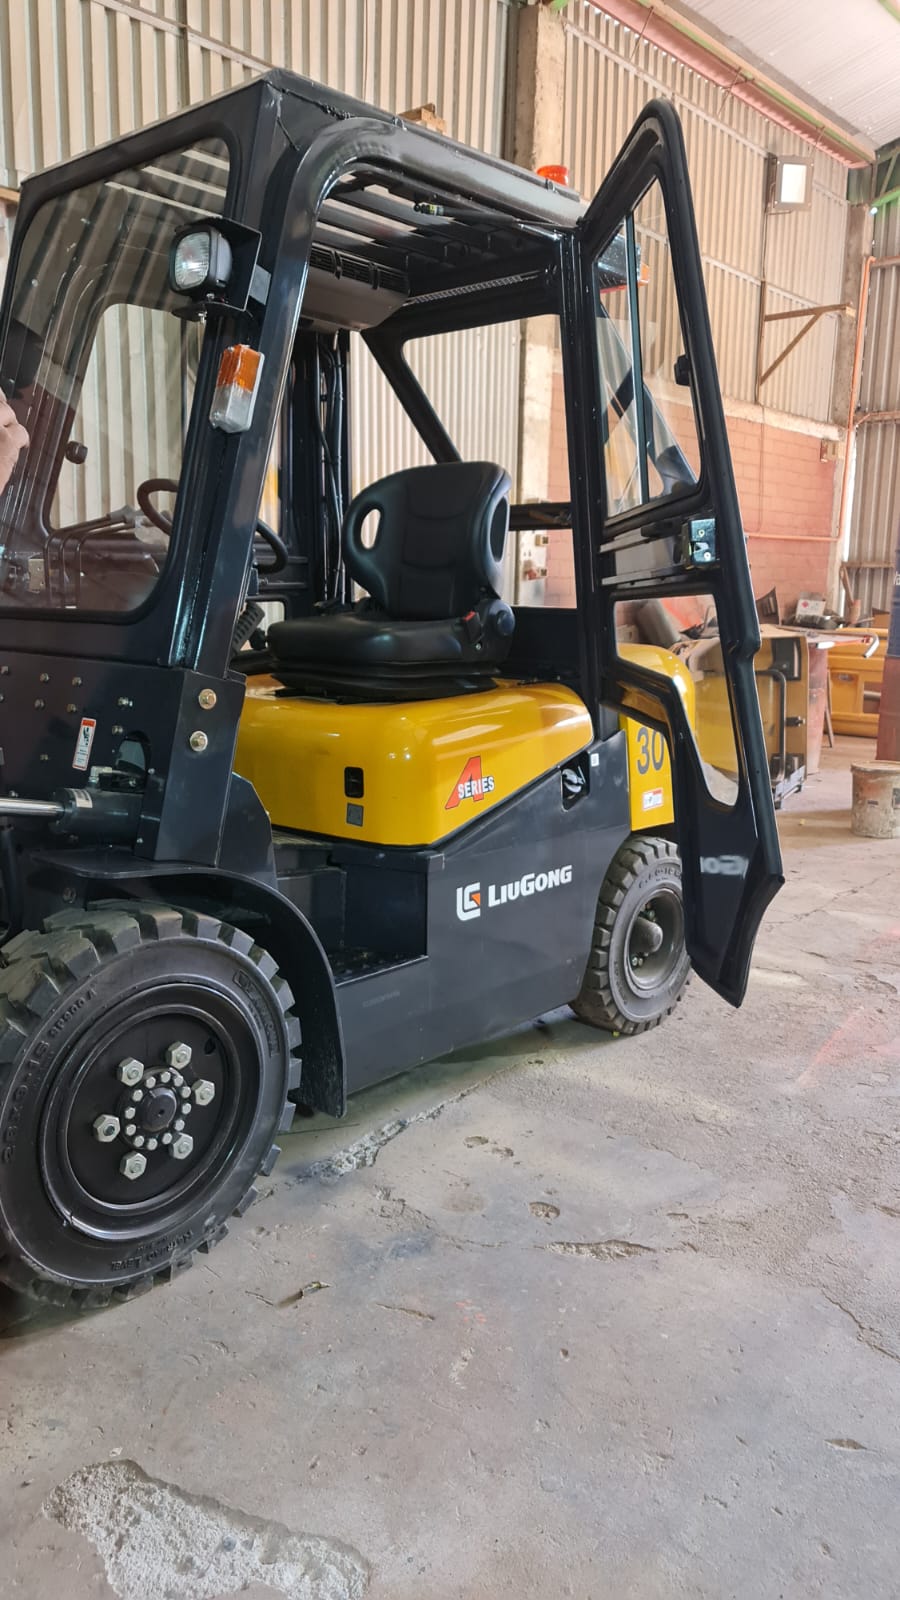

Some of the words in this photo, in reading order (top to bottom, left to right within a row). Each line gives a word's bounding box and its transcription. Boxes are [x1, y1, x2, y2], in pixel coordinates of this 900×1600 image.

[636, 727, 665, 775] 30
[444, 755, 484, 810] A
[457, 776, 495, 800] SERIES
